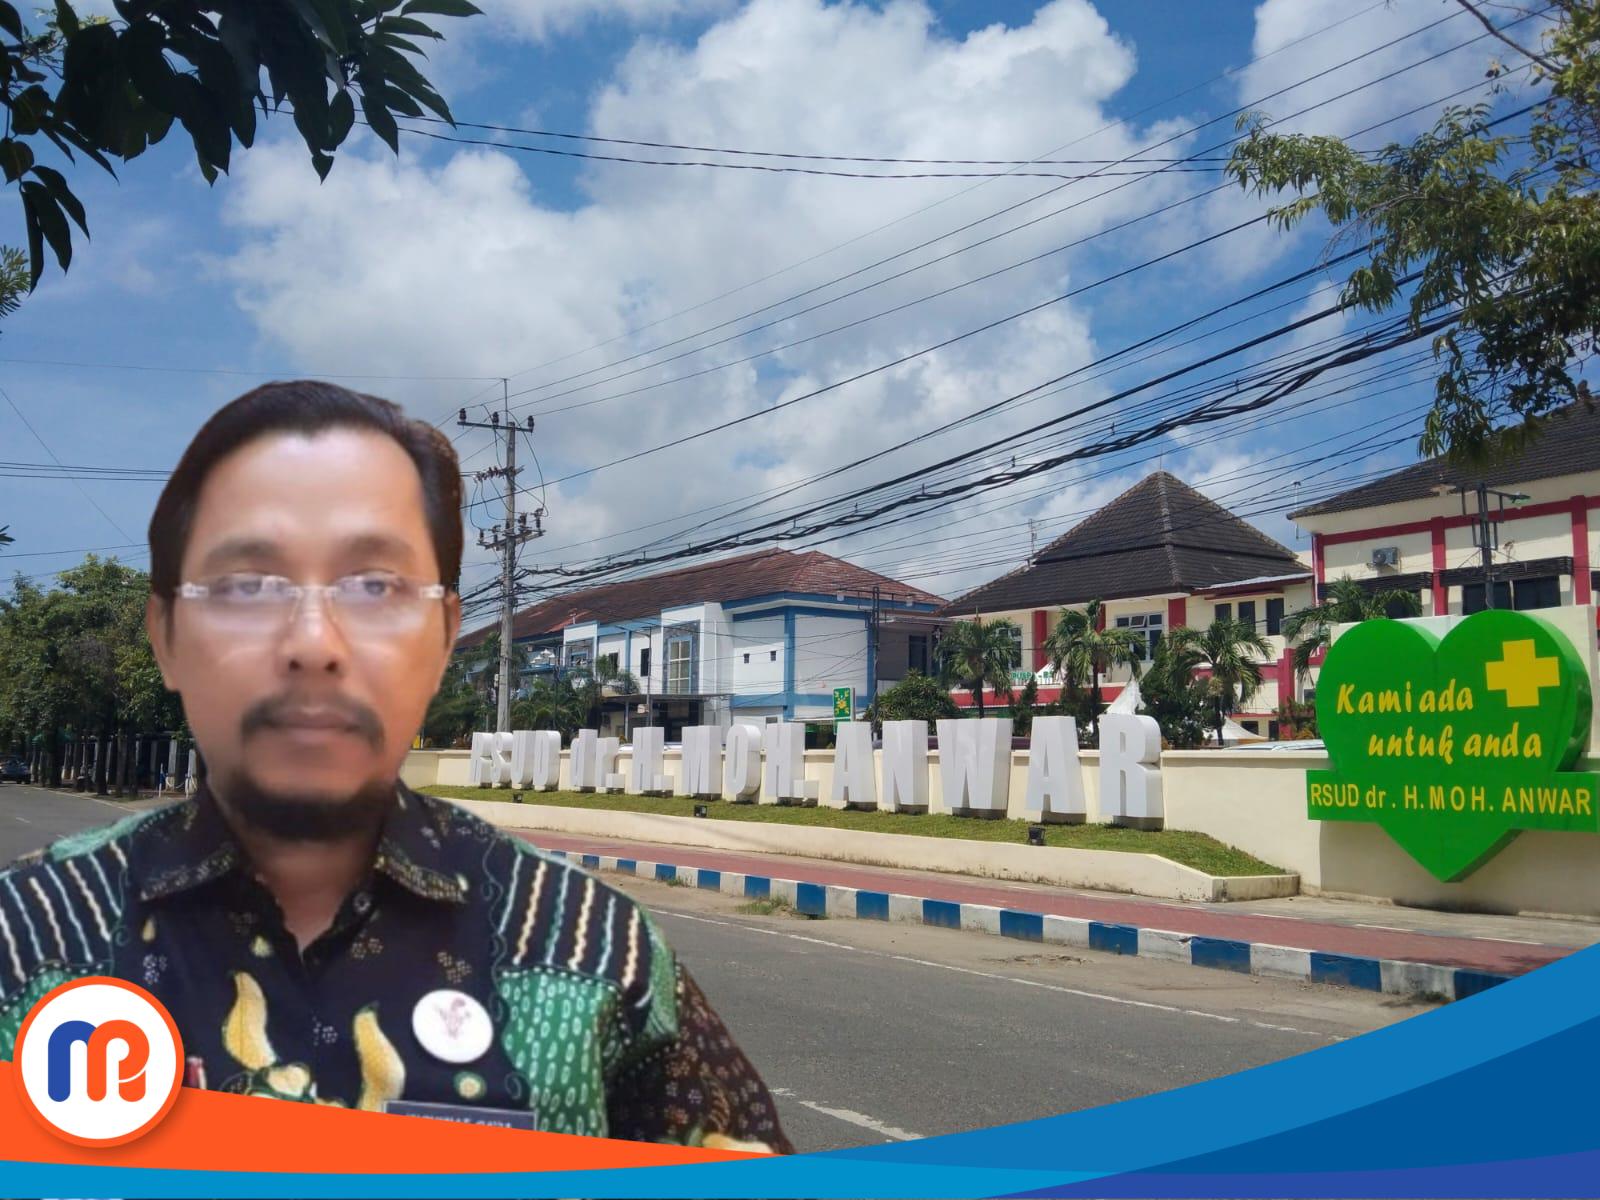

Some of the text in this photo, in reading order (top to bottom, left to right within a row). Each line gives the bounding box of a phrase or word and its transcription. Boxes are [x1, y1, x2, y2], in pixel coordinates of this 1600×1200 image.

[1337, 679, 1473, 714] Kami ada
[1368, 722, 1542, 764] untuk anda
[832, 714, 1164, 818] ANWAR
[1310, 783, 1359, 807] RSUD
[1502, 787, 1591, 815] ANWAR
